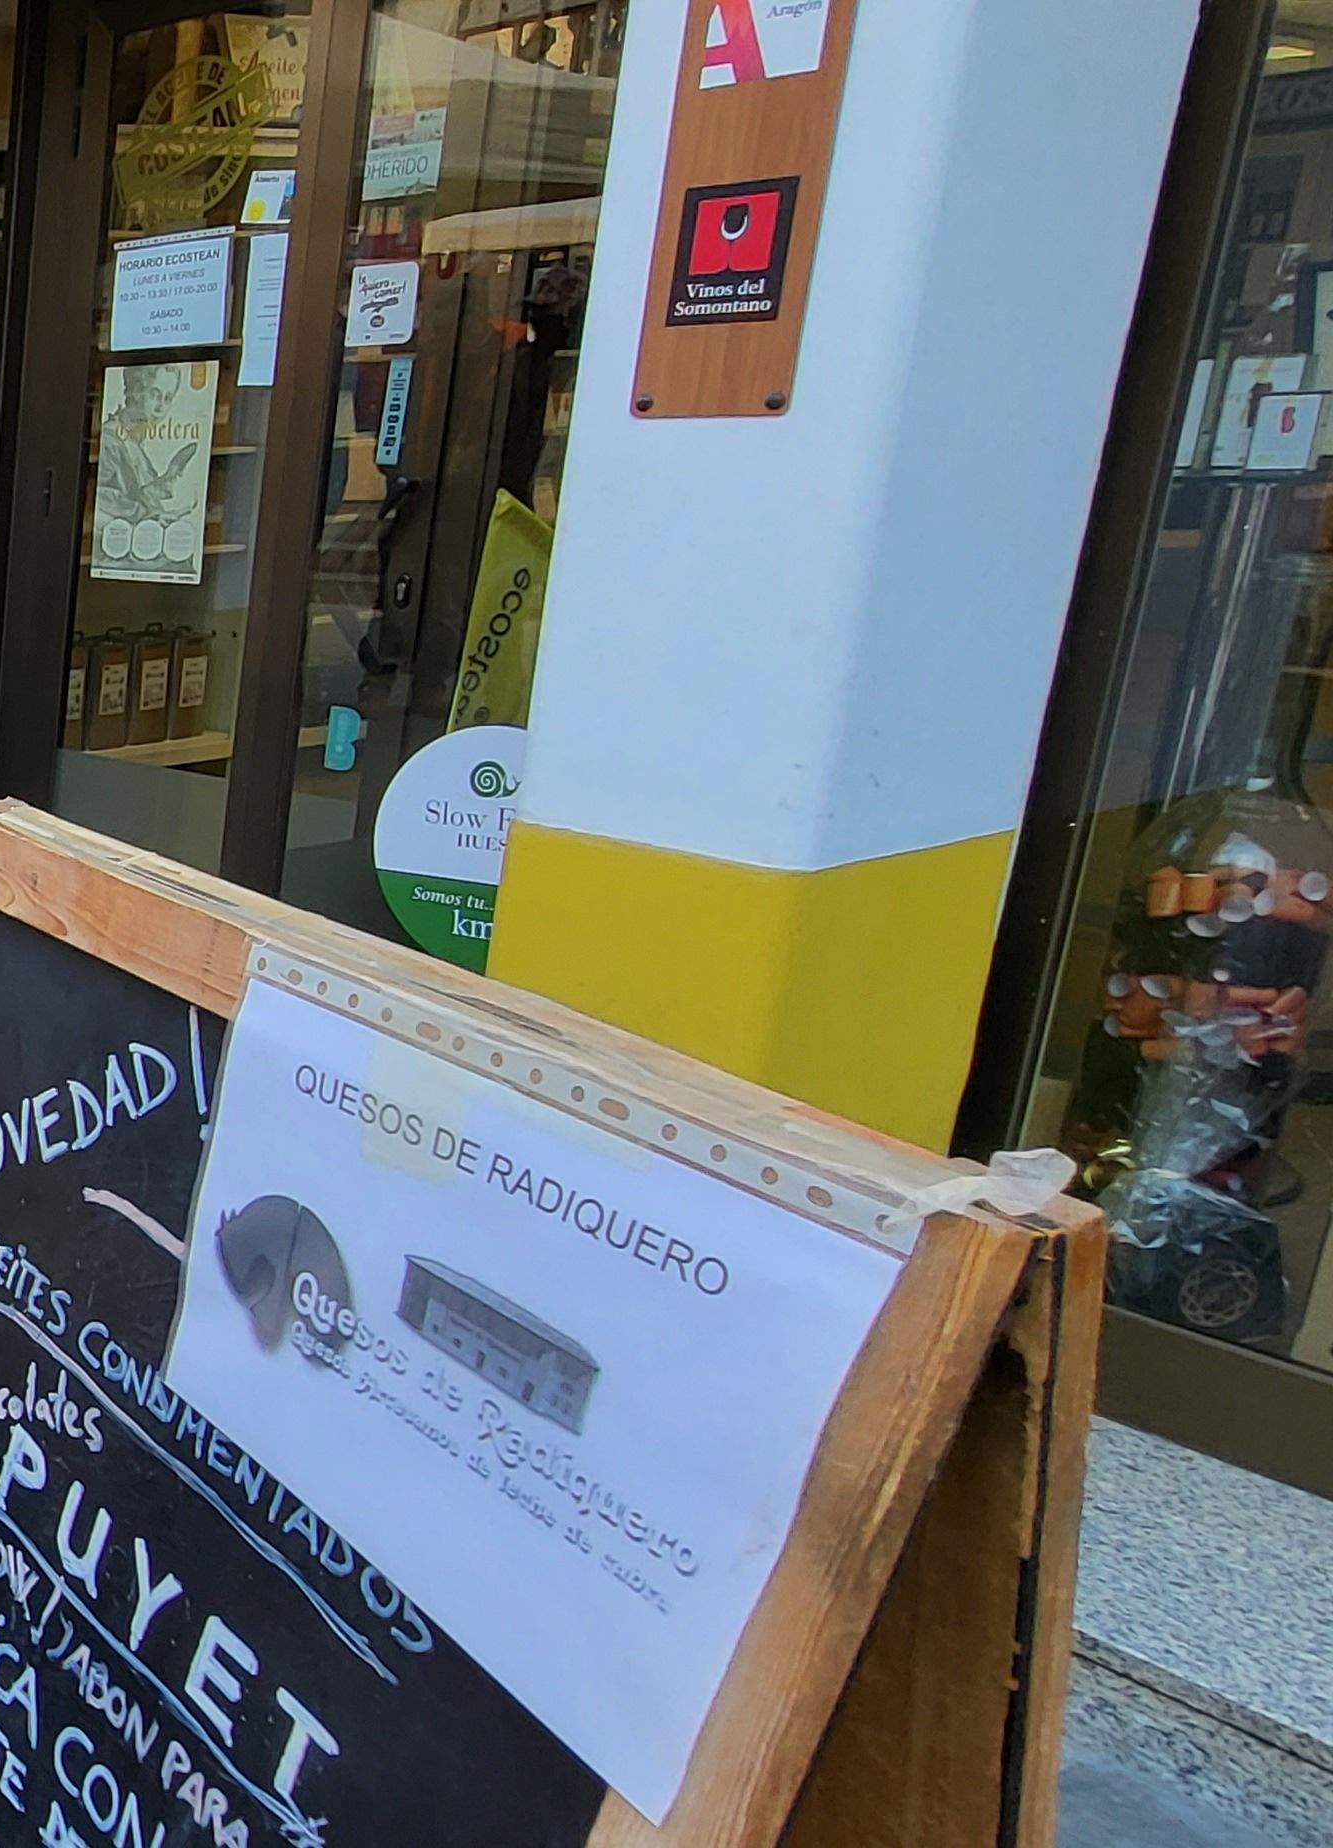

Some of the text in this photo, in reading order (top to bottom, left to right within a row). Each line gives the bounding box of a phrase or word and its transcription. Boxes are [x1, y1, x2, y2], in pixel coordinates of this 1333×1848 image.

[119, 249, 220, 273] HORARIO ECOSTEAN
[169, 268, 205, 281] VIERNES
[686, 278, 765, 298] Vinos del
[674, 299, 773, 316] Somontano
[424, 799, 488, 829] Slow
[412, 886, 462, 907] Somos
[294, 1064, 730, 1296] QUESOS DE RADIQUERO
[293, 1271, 409, 1375] Quesos
[477, 1399, 700, 1578] Radiquero
